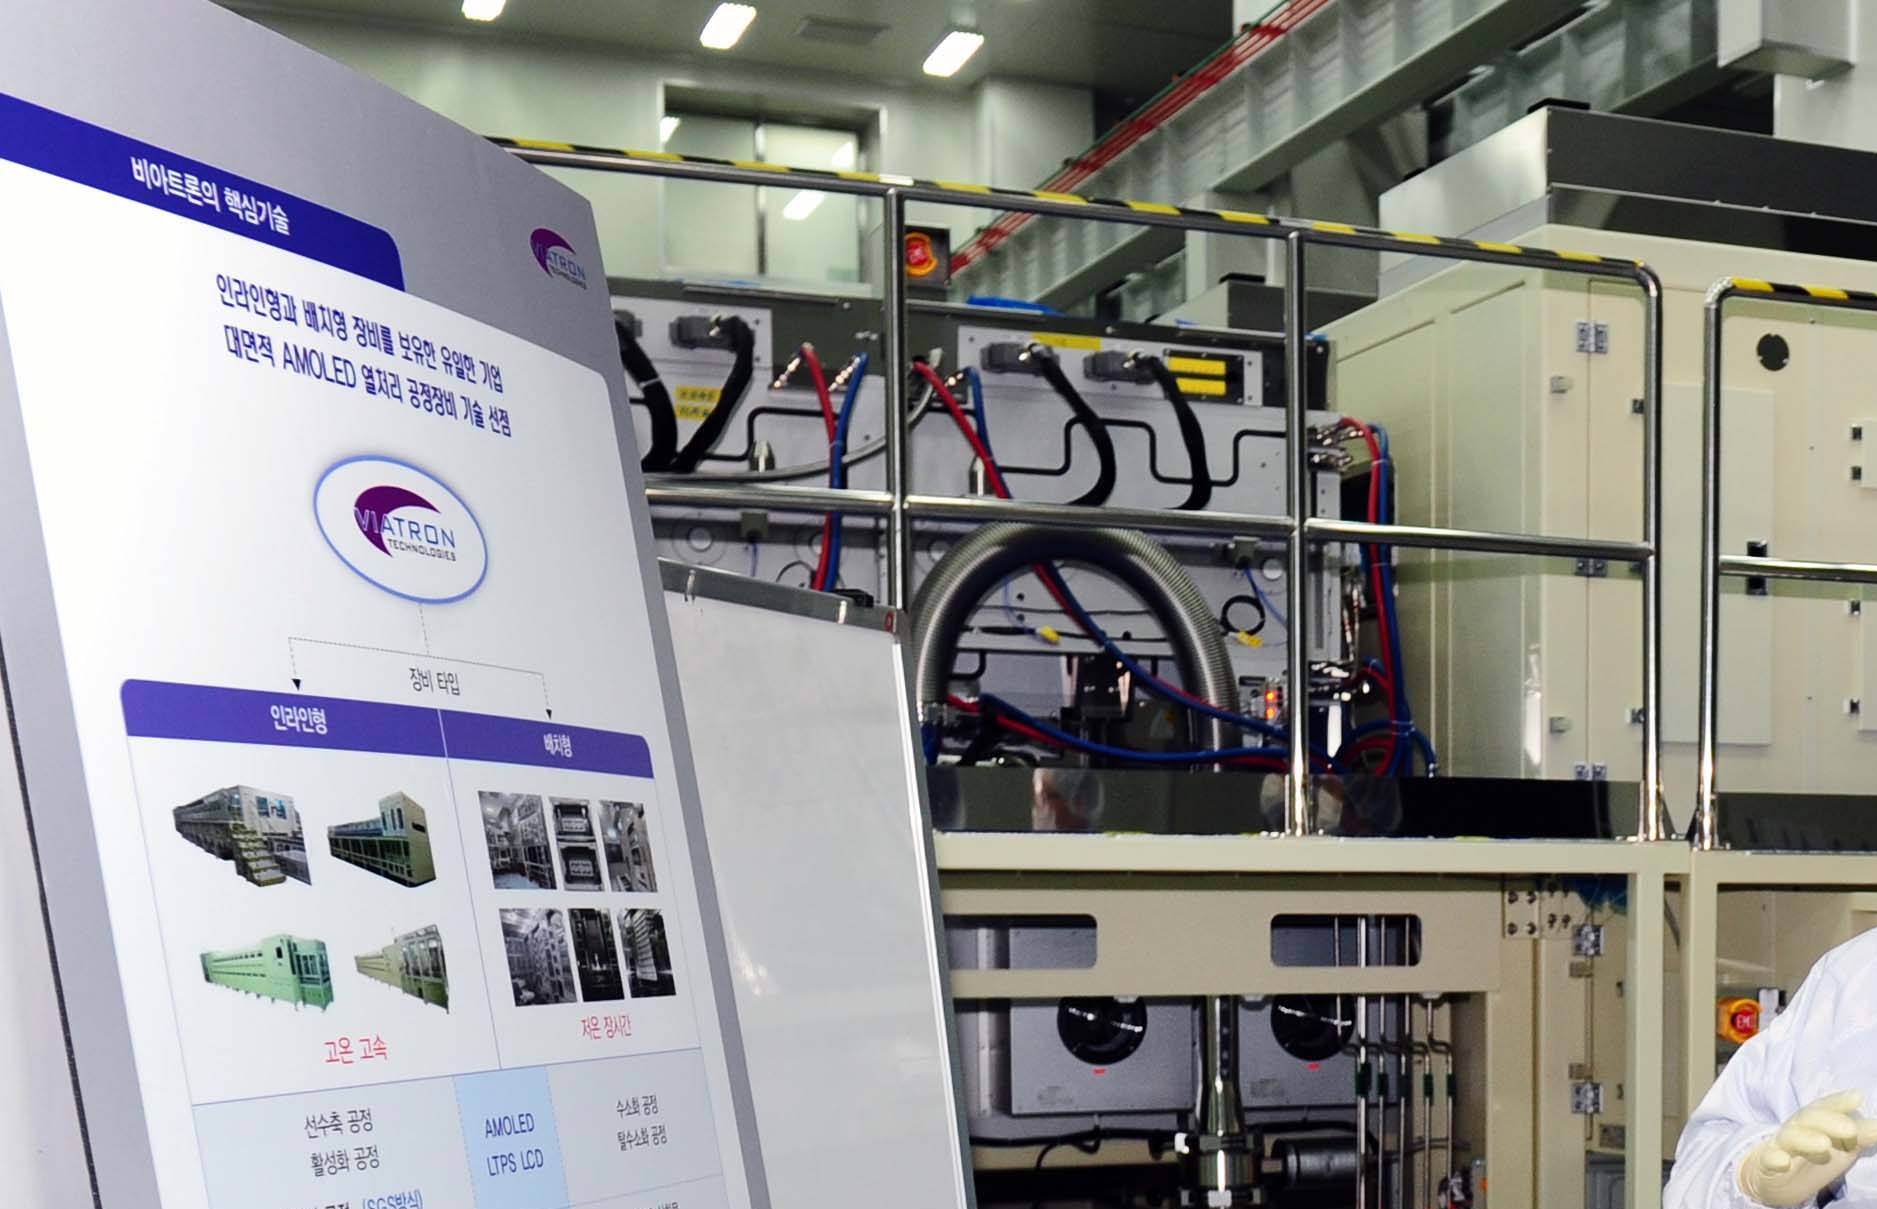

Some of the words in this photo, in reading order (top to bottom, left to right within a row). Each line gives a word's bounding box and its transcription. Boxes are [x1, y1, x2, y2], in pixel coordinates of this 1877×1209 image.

[130, 156, 221, 212] 비아트론의
[224, 187, 290, 236] 핵심기술
[216, 274, 298, 326] 인라인형과
[302, 300, 348, 341] 배치형
[352, 316, 394, 356] 장비를
[398, 331, 437, 370] 보유한
[440, 346, 477, 384] 유일한
[479, 360, 504, 393] 기업
[224, 325, 275, 367] 대면적
[283, 342, 356, 388] AMOLED
[361, 364, 403, 403] 열처리
[406, 378, 458, 420] 공정장비
[460, 395, 485, 428] 기술
[488, 405, 512, 437] 선점
[354, 507, 456, 548] VIATRON
[387, 538, 457, 561] TECHNOLOGIES
[409, 667, 434, 693] 장비
[436, 672, 461, 696] 타입
[270, 704, 328, 735] 인라인형
[603, 1014, 633, 1039] 장시간
[323, 1036, 354, 1064] 고온
[358, 1034, 388, 1061] 고속
[642, 1094, 659, 1116] 공정
[304, 1110, 343, 1139] 선수축
[347, 1107, 374, 1134] 공정
[485, 1113, 535, 1138] AMOLED
[651, 1125, 668, 1146] 공정
[311, 1149, 350, 1177] 활성화
[353, 1145, 380, 1171] 공정
[486, 1152, 517, 1176] LTPS
[520, 1149, 544, 1170] LCD
